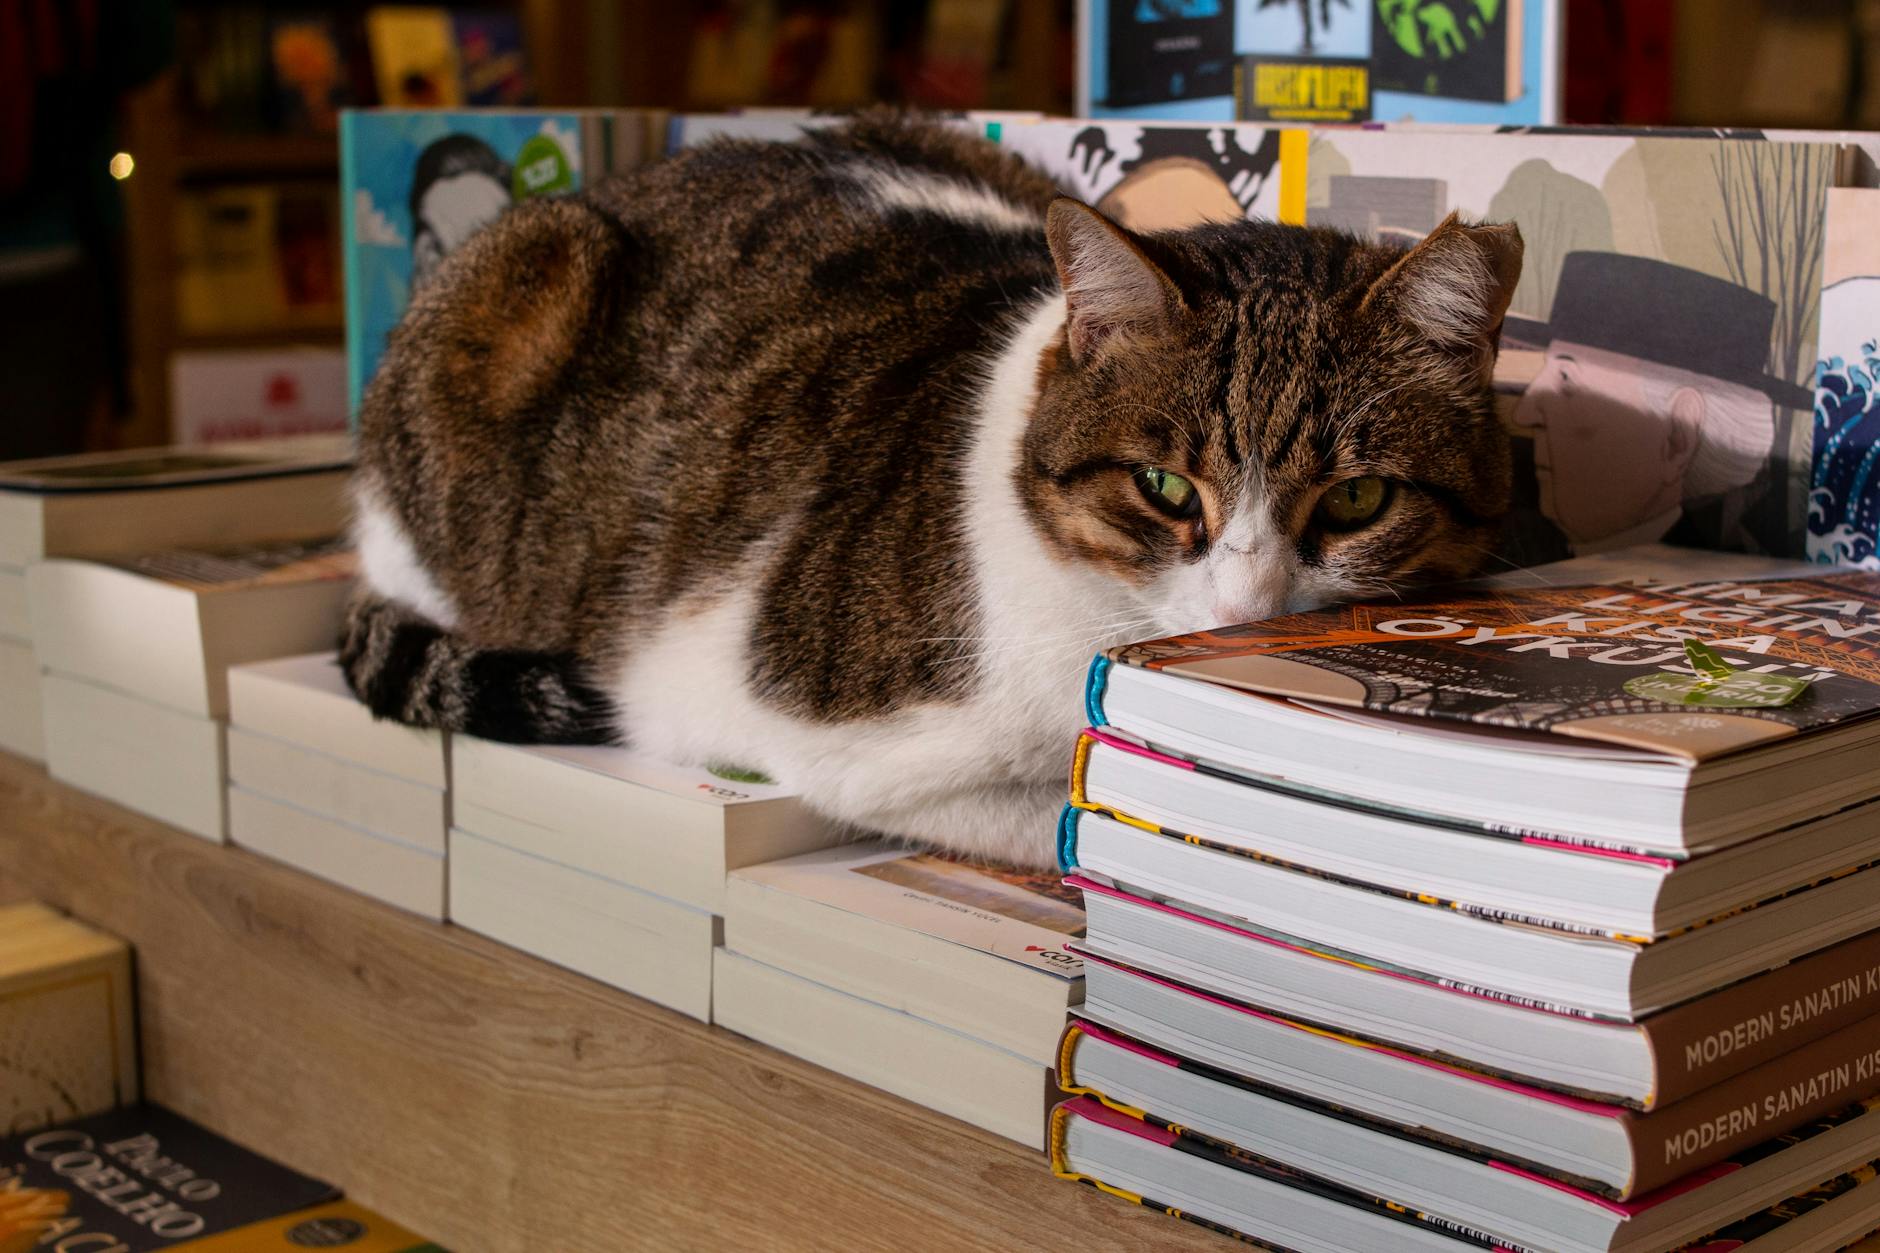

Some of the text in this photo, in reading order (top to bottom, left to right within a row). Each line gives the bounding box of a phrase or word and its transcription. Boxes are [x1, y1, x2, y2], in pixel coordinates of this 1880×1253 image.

[1528, 611, 1777, 654] KISA
[1685, 1011, 1774, 1071] MODERN
[1779, 974, 1861, 1030] SANATIN
[1664, 1102, 1758, 1165] MODERN
[1763, 1063, 1850, 1121] SANATIN
[24, 1129, 205, 1239] COELHO
